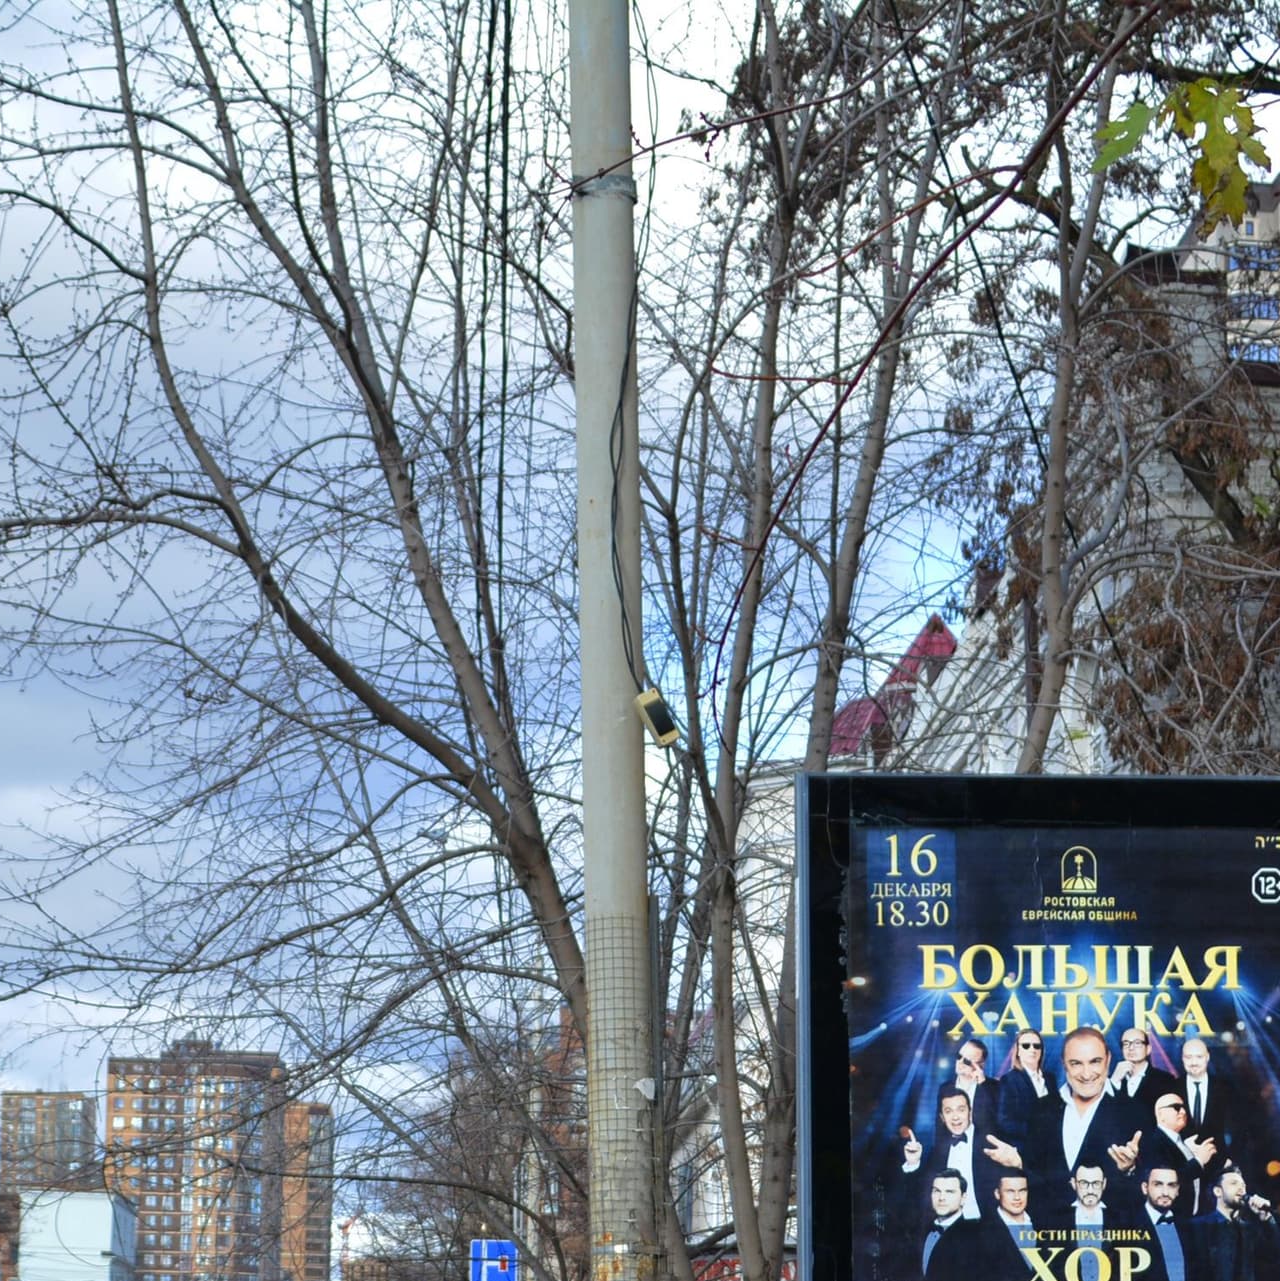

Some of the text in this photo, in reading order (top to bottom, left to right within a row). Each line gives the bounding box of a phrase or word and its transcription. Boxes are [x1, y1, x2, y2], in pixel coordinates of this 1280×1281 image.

[886, 834, 938, 877] 16
[870, 881, 953, 898] ДЕКАБРЯ
[1044, 896, 1116, 907] РОСТОВСКАЯ
[875, 900, 950, 926] 18.30
[1022, 909, 1138, 922] ЕВРЕЙСКАЯ ОБЩИНА
[917, 944, 1242, 991] БОЛЬШАЯ
[947, 990, 1216, 1036] ХАНУКА
[1020, 1228, 1151, 1243] ГОСТИ ПРАЗДНИКА
